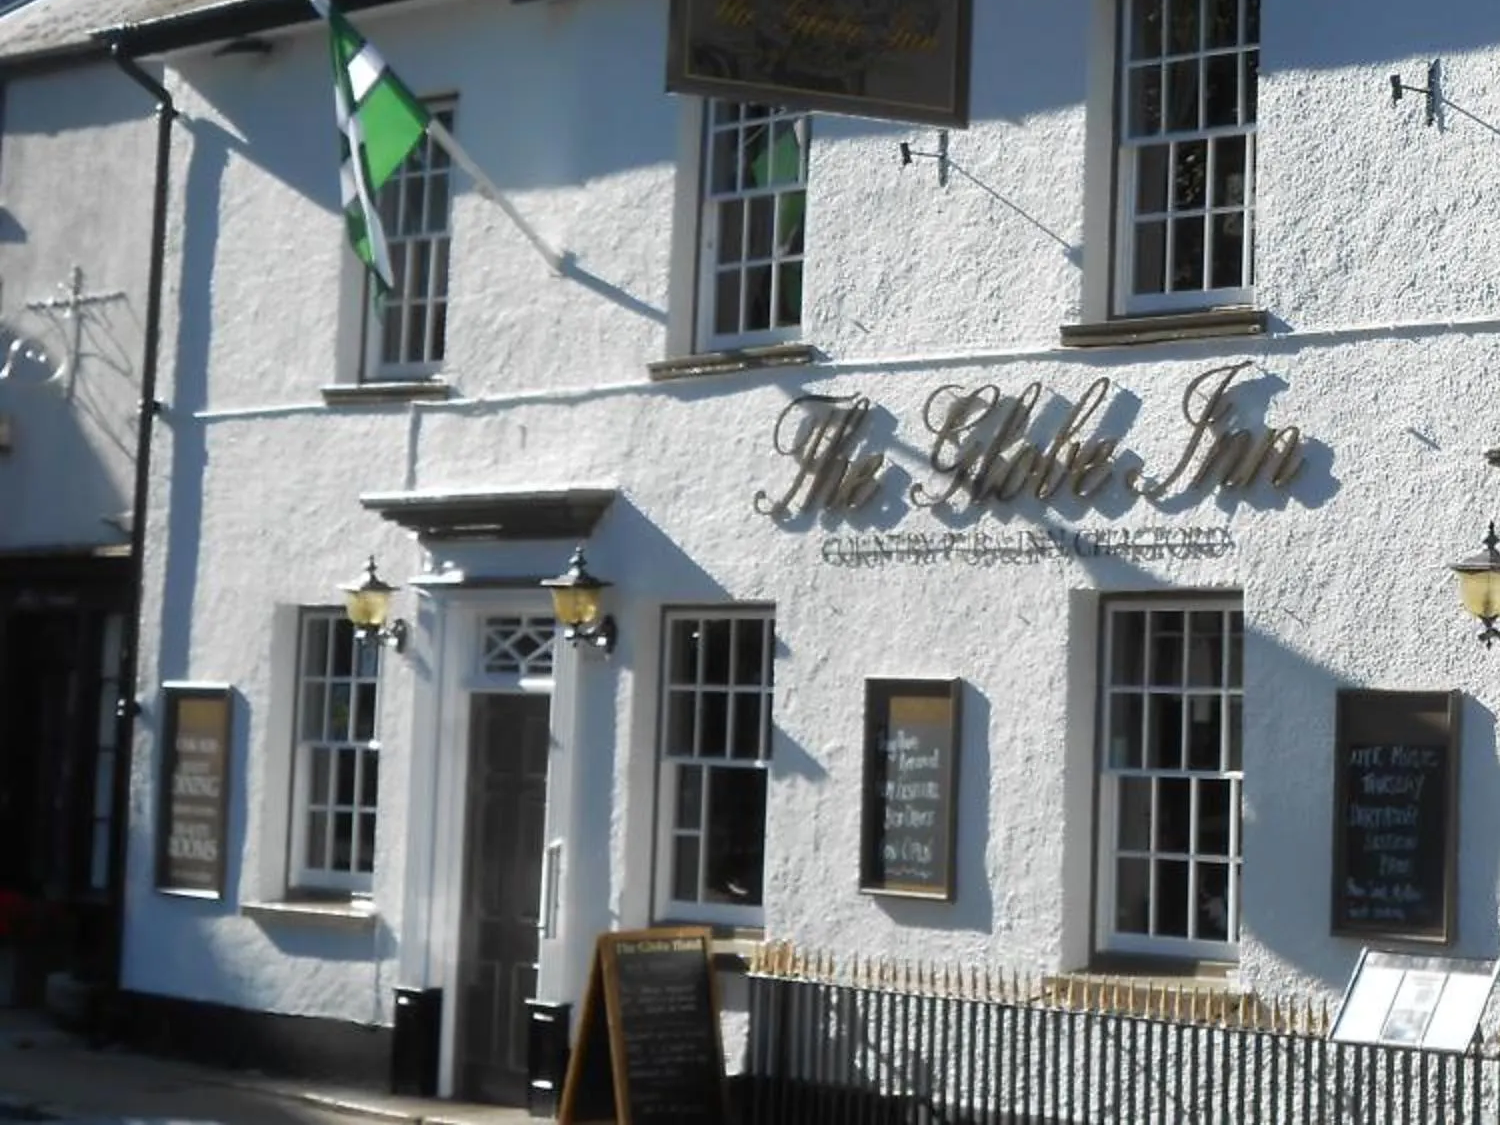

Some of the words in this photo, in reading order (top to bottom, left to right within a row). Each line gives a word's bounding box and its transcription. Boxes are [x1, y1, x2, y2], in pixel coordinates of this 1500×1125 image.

[754, 391, 887, 515] The
[909, 377, 1117, 508] Globe
[1125, 360, 1306, 499] Inn
